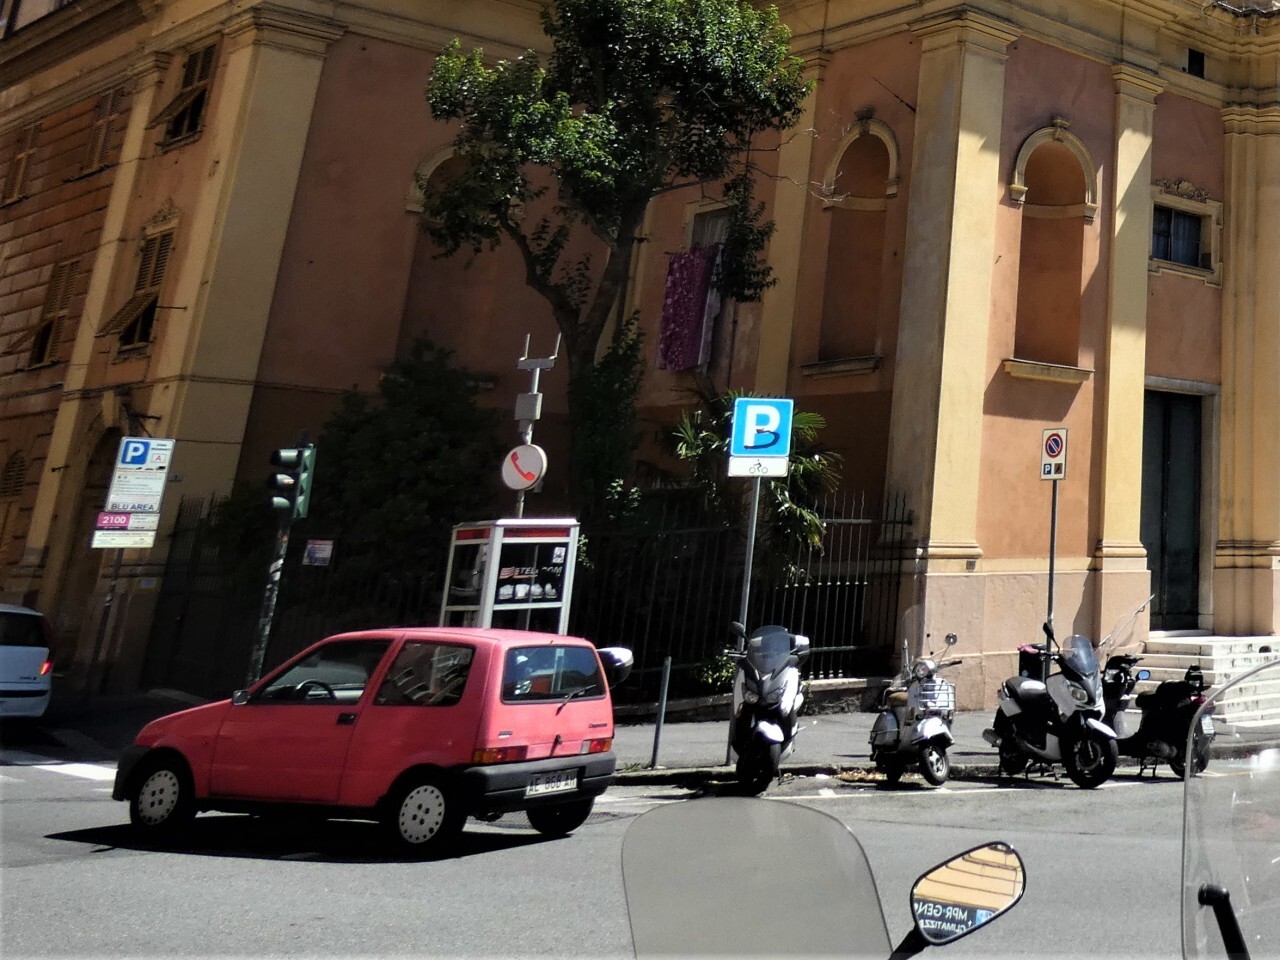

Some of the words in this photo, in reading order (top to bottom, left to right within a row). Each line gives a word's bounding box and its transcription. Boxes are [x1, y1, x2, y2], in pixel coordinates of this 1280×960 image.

[125, 443, 145, 462] P
[1044, 464, 1051, 474] P
[130, 503, 154, 511] AREA
[102, 516, 127, 524] 2100
